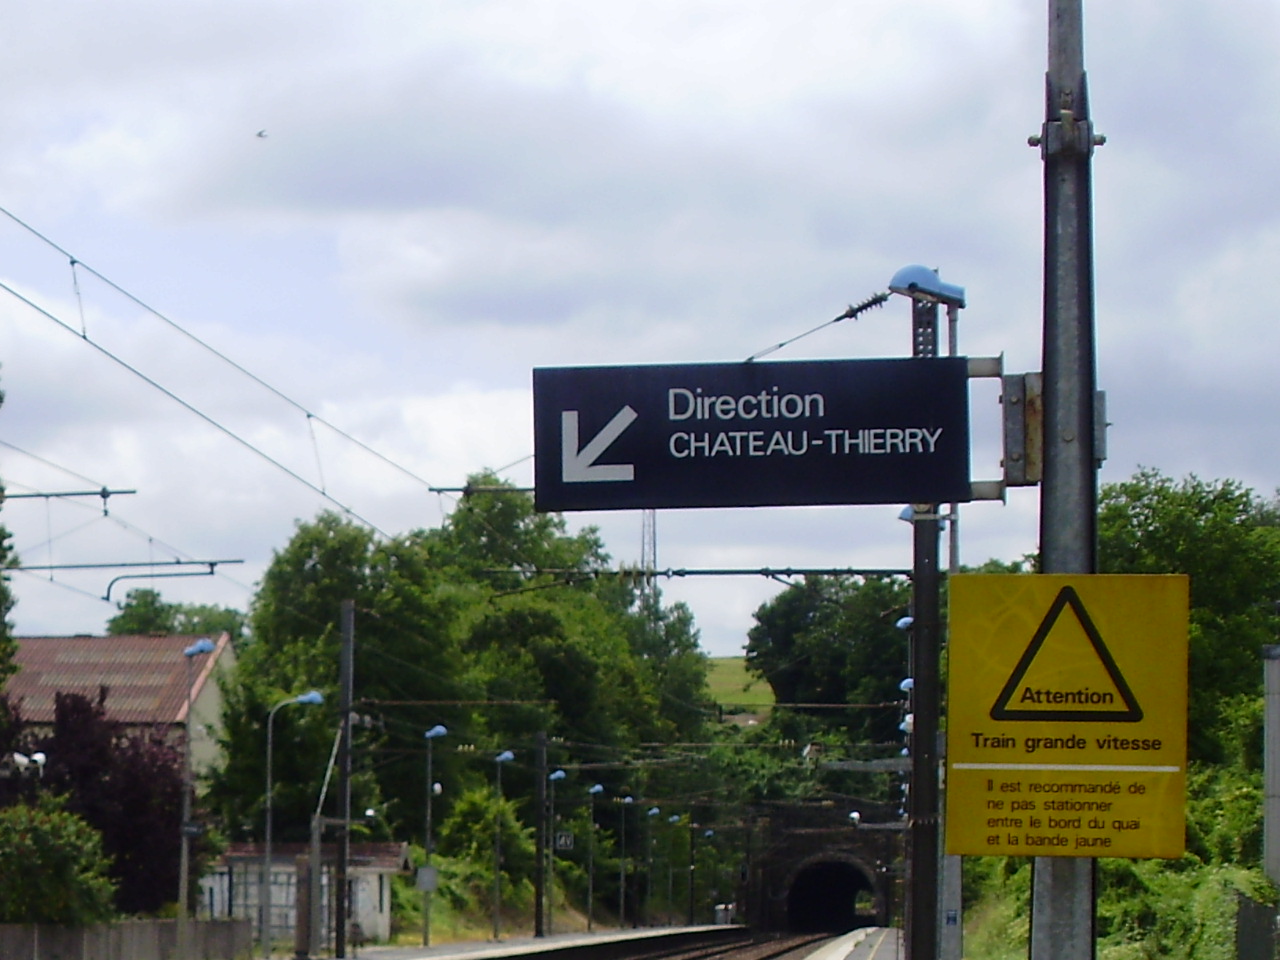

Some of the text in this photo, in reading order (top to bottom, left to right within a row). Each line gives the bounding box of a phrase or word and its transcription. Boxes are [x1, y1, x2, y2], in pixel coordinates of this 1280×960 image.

[668, 386, 824, 421] Direction
[669, 427, 942, 457] CHATEAU-THIERRY
[1021, 687, 1114, 704] Attention
[971, 733, 1162, 753] Train grande vitesse
[987, 780, 1146, 794] Il est recommandé de
[987, 799, 1113, 814] ne pas stationner
[987, 815, 1140, 832] entre le bord du quai
[987, 832, 1111, 849] et la bande jaune
